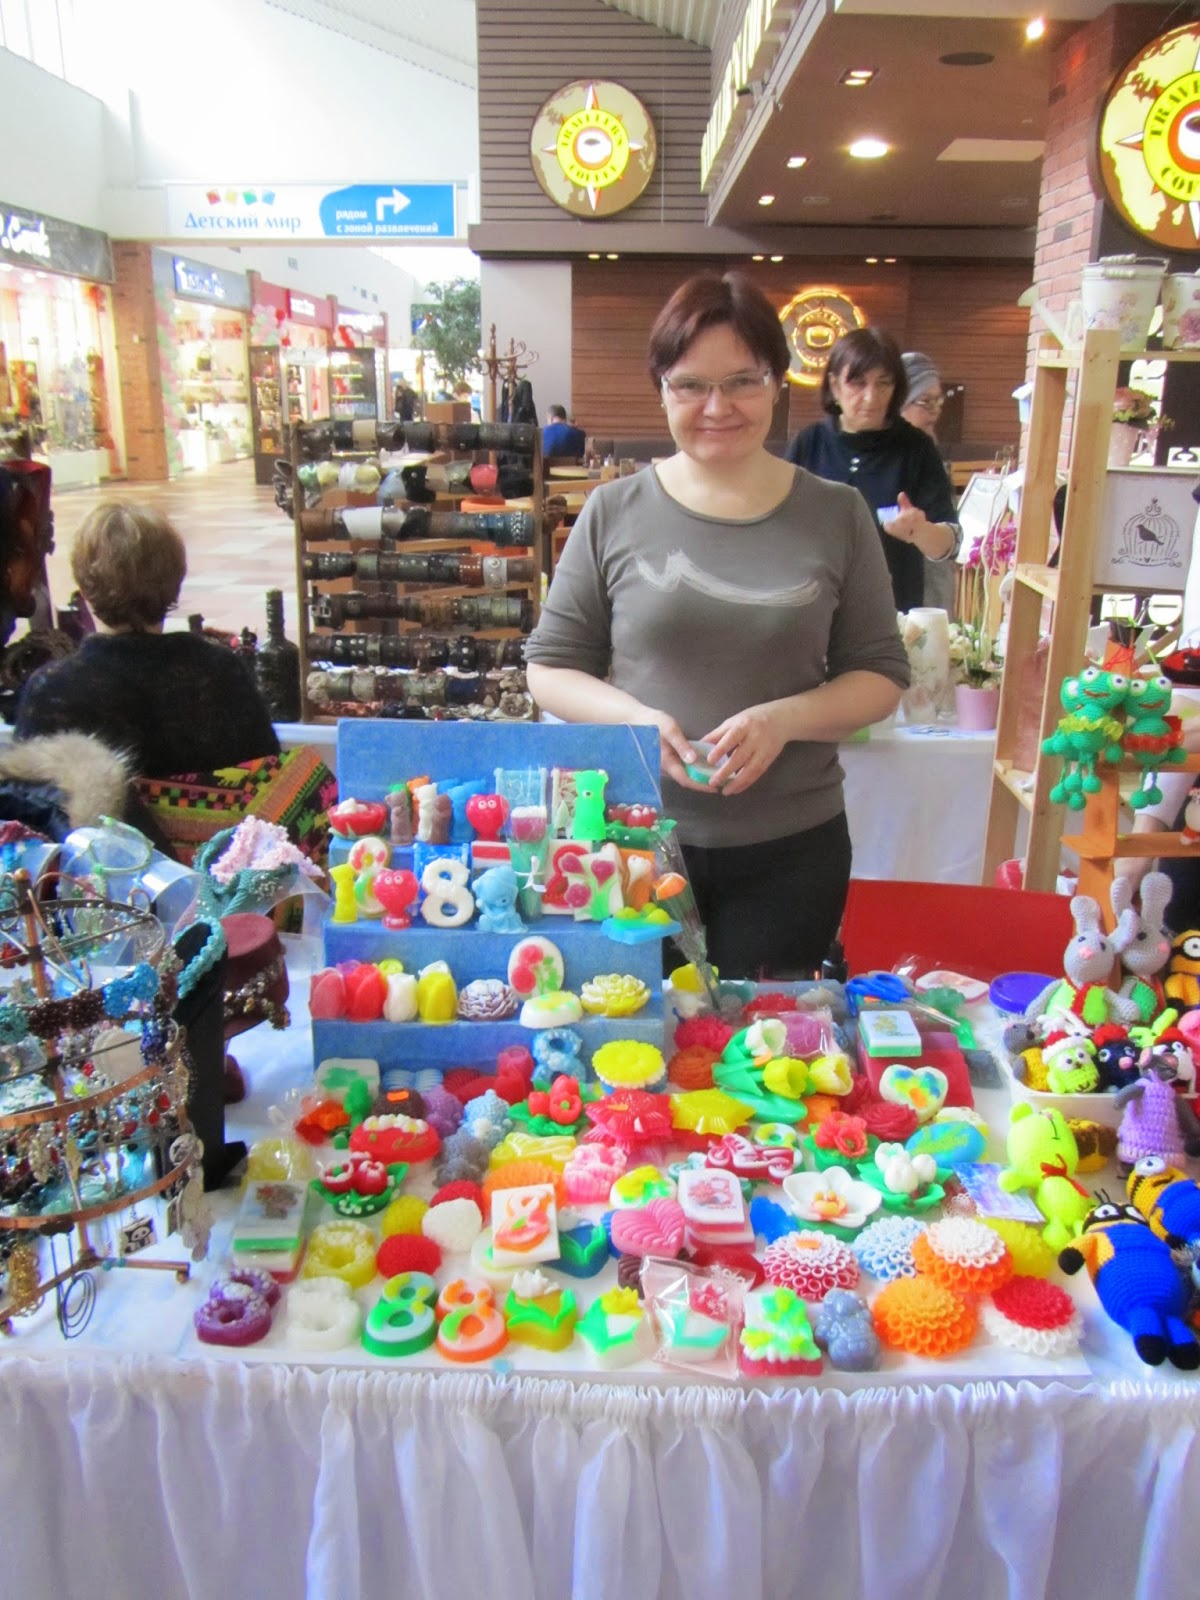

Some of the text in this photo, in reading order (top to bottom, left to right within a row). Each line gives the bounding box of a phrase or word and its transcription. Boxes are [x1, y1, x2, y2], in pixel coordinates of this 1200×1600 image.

[184, 211, 301, 234] Детский мир
[335, 210, 368, 221] рядом
[336, 222, 439, 235] с зоной развлечений
[421, 857, 475, 928] 8
[361, 1270, 438, 1357] 8
[435, 1276, 510, 1363] 8
